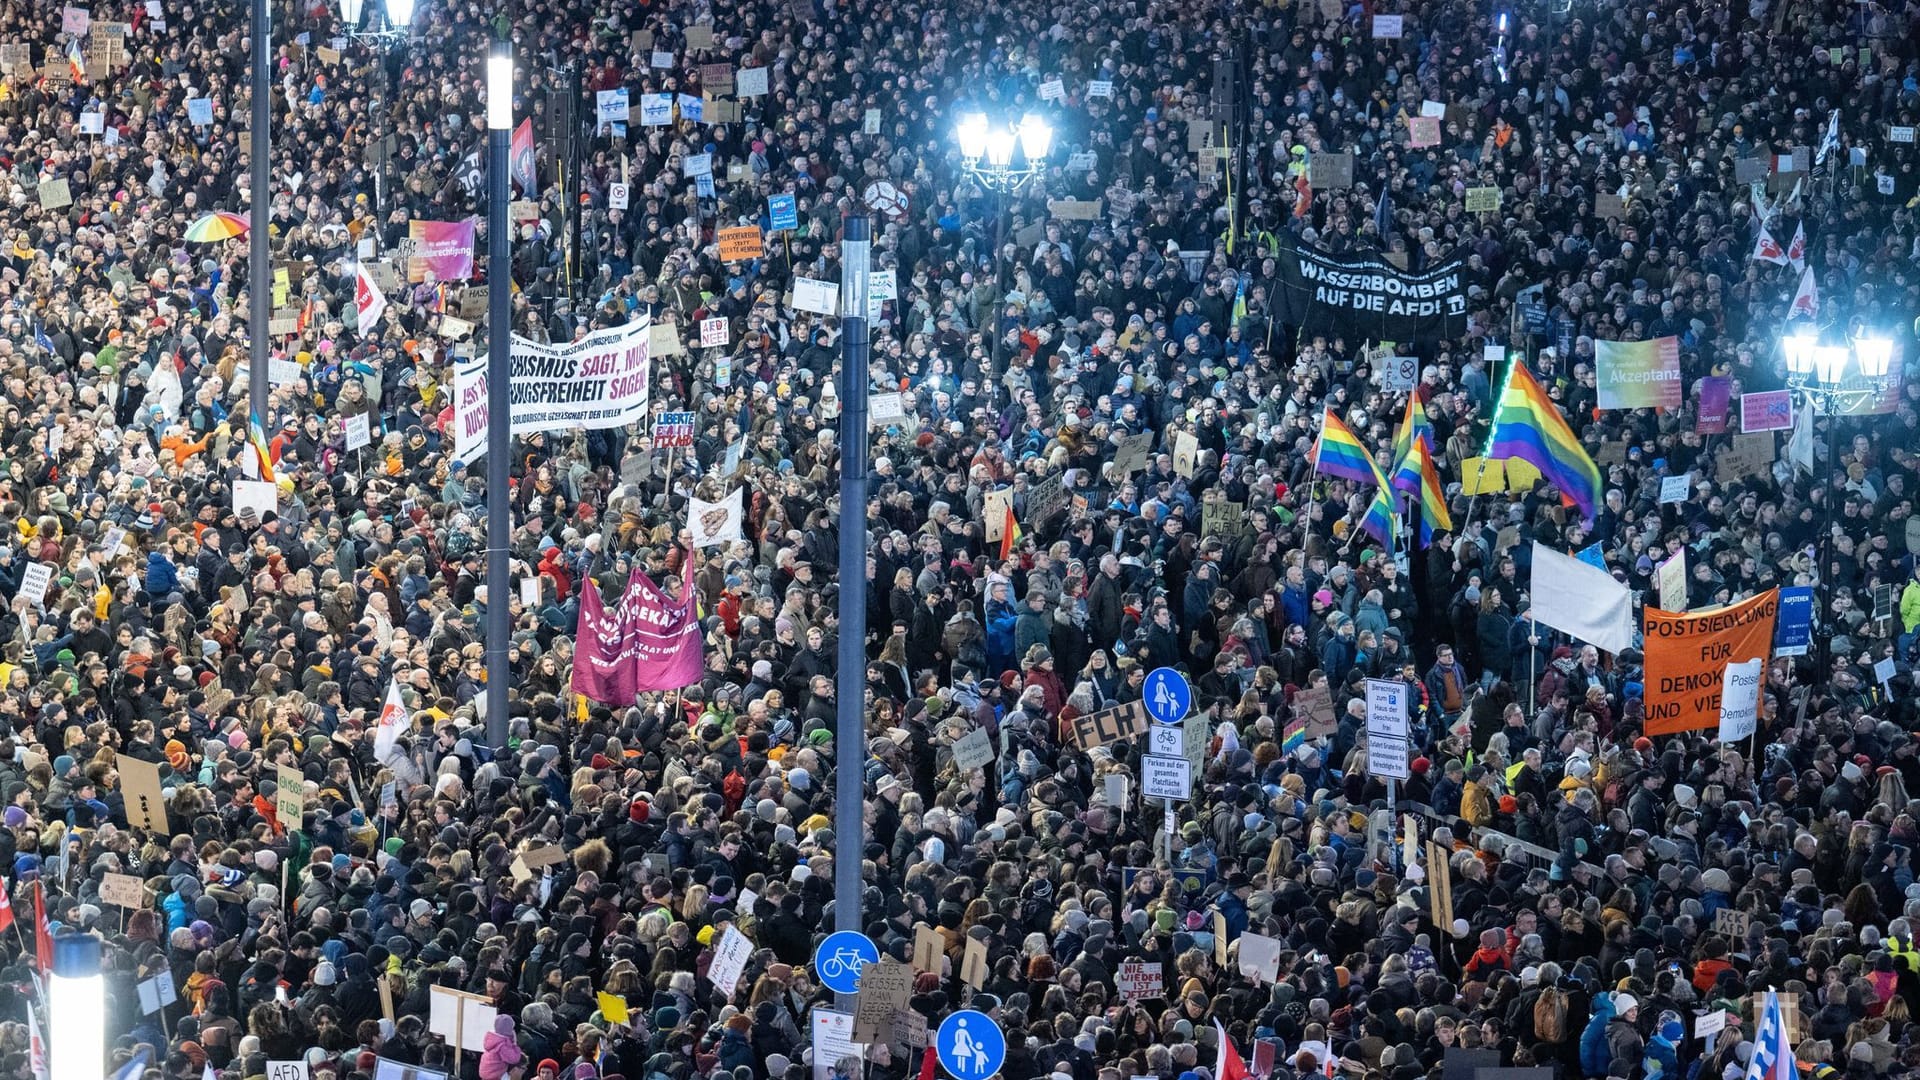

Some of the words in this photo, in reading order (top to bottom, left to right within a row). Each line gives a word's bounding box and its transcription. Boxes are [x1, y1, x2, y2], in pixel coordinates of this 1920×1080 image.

[1300, 260, 1458, 298] WASSERBOMBEN
[1316, 286, 1349, 307] AUF
[1353, 293, 1385, 311] DIE
[1388, 300, 1441, 316] AFD!
[510, 355, 577, 379] CHISMUS
[580, 350, 620, 378] SAGT,
[1610, 368, 1680, 385] Akzeptanz
[1645, 601, 1775, 638] POSTSIEDLUNG
[1701, 641, 1732, 662] FÜR
[1372, 683, 1400, 694] Berechtigte
[1644, 702, 1681, 720] UND
[1373, 713, 1400, 723] Geschichte
[1161, 744, 1172, 752] frei
[1148, 759, 1167, 768] Parken
[1167, 760, 1175, 768] auf
[1176, 761, 1185, 769] der
[1154, 769, 1179, 779] gesamten
[1152, 777, 1180, 787] Platzfläche
[1150, 785, 1163, 794] nicht
[1164, 787, 1182, 796] erlaubt
[1720, 911, 1744, 923] FCK
[1124, 964, 1144, 975] NIE
[1120, 972, 1162, 982] WIEDER
[860, 978, 906, 991] WEISSER
[1133, 982, 1151, 990] IST
